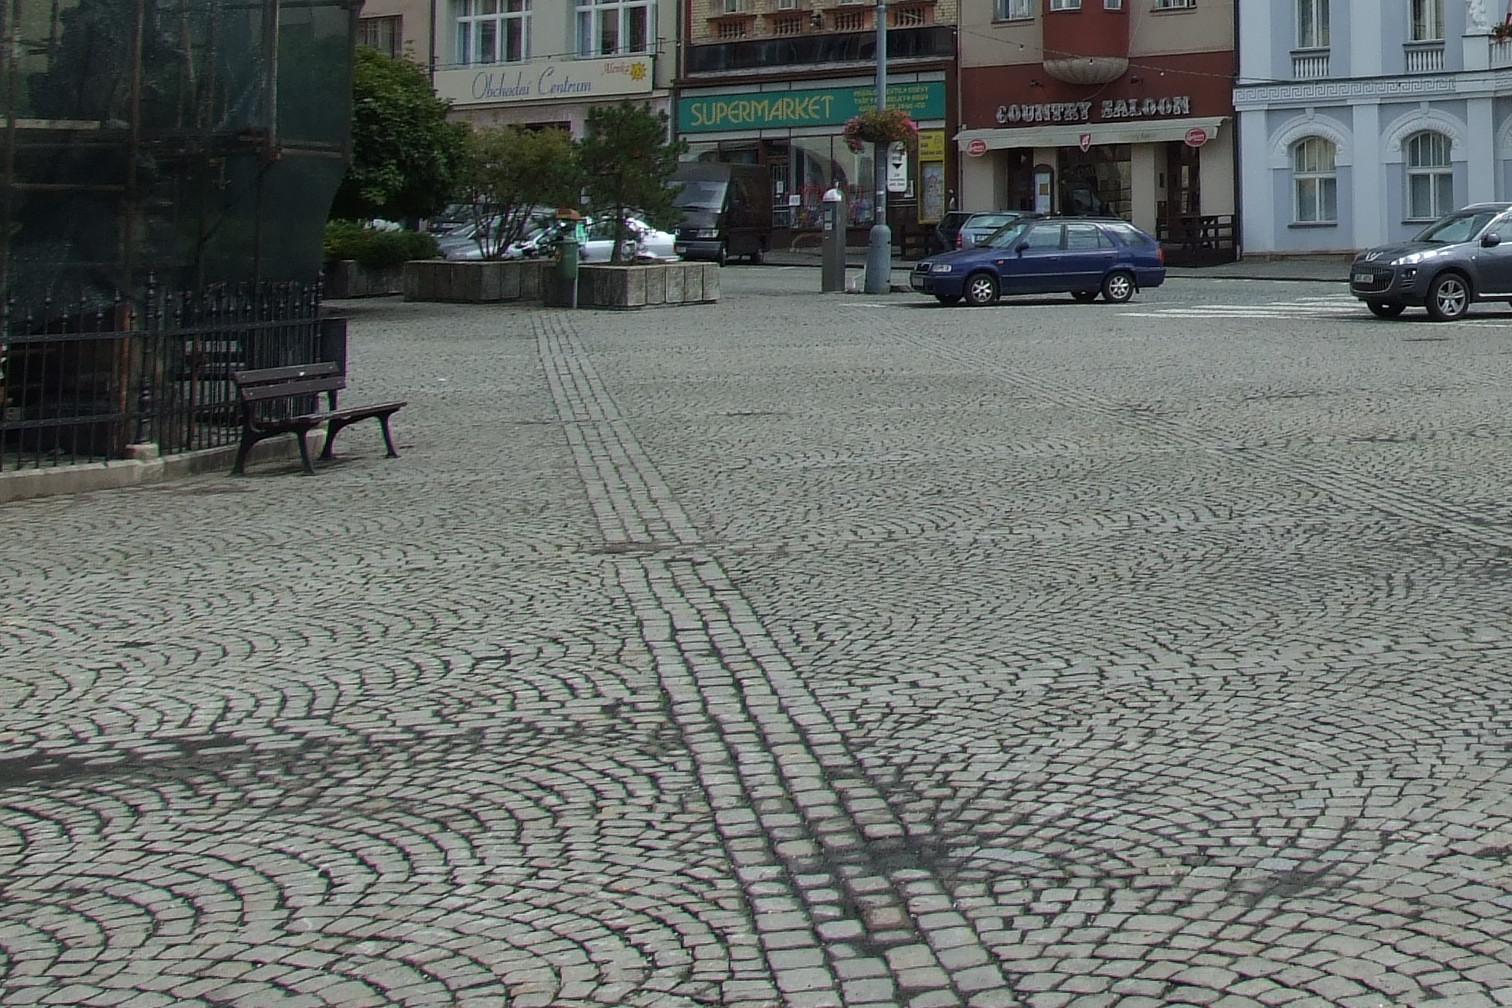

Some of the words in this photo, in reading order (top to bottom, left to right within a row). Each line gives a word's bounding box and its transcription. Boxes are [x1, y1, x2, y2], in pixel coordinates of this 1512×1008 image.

[538, 66, 592, 96] Centrum
[691, 95, 834, 126] SUPERMARKET
[996, 101, 1092, 124] COUNTRY
[1101, 96, 1191, 119] SALOON
